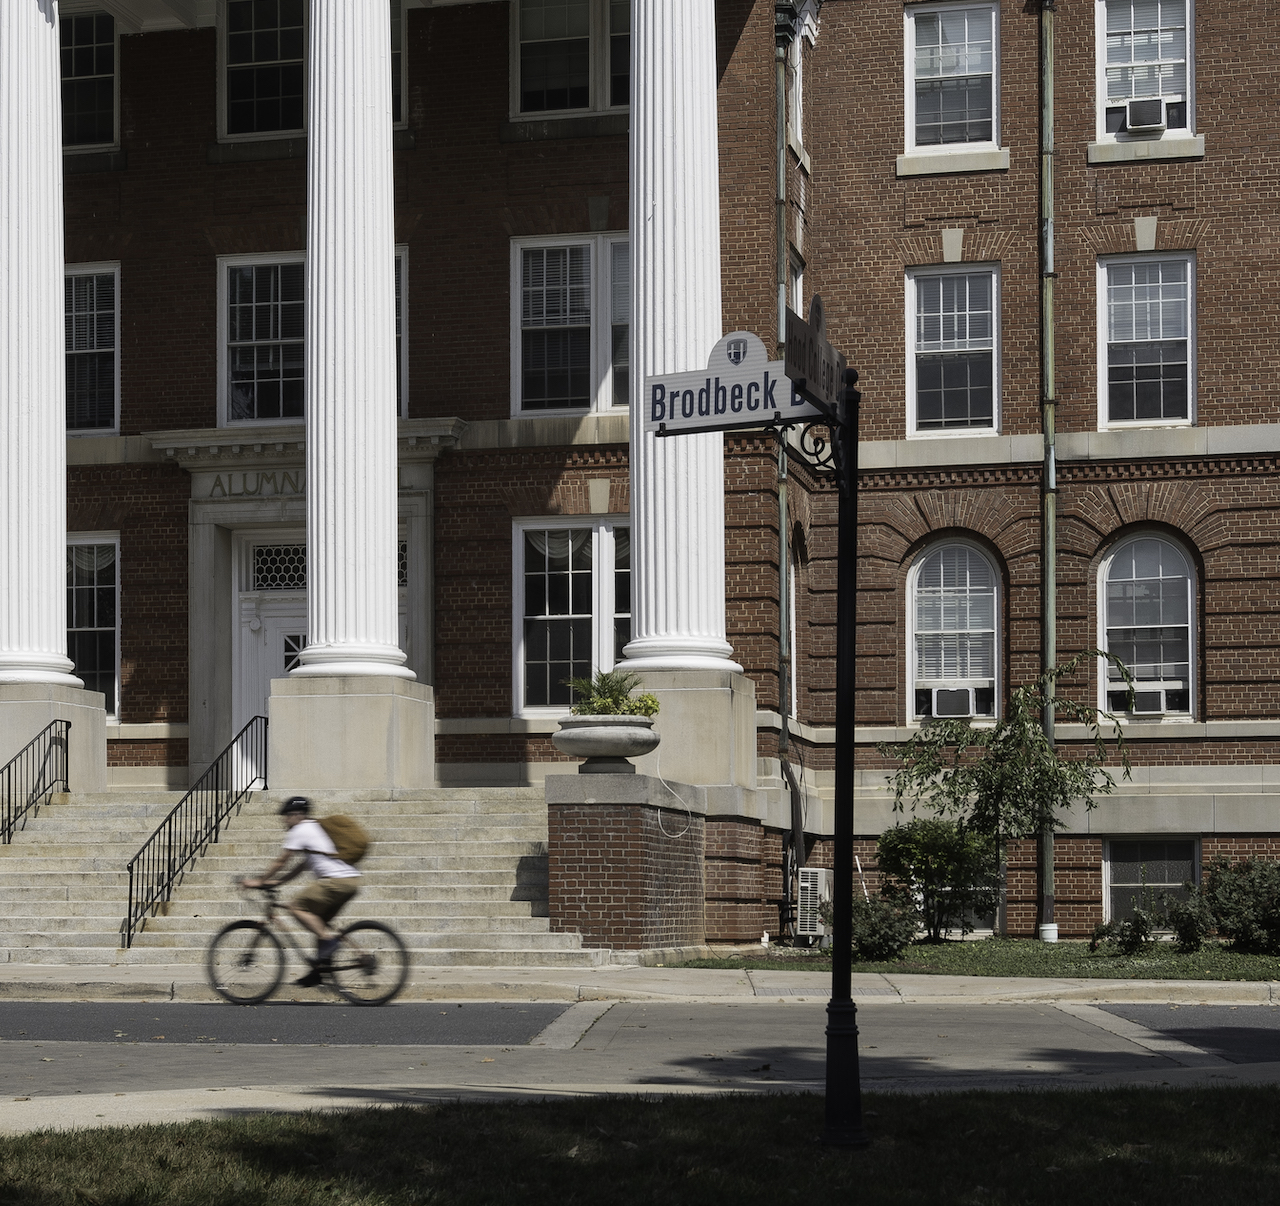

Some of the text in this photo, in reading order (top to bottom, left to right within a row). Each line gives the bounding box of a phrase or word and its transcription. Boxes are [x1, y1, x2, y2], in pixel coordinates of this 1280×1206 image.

[788, 319, 806, 375] Hood
[808, 337, 834, 401] College
[651, 370, 778, 422] Brodbeck
[209, 470, 306, 497] ALUMN
